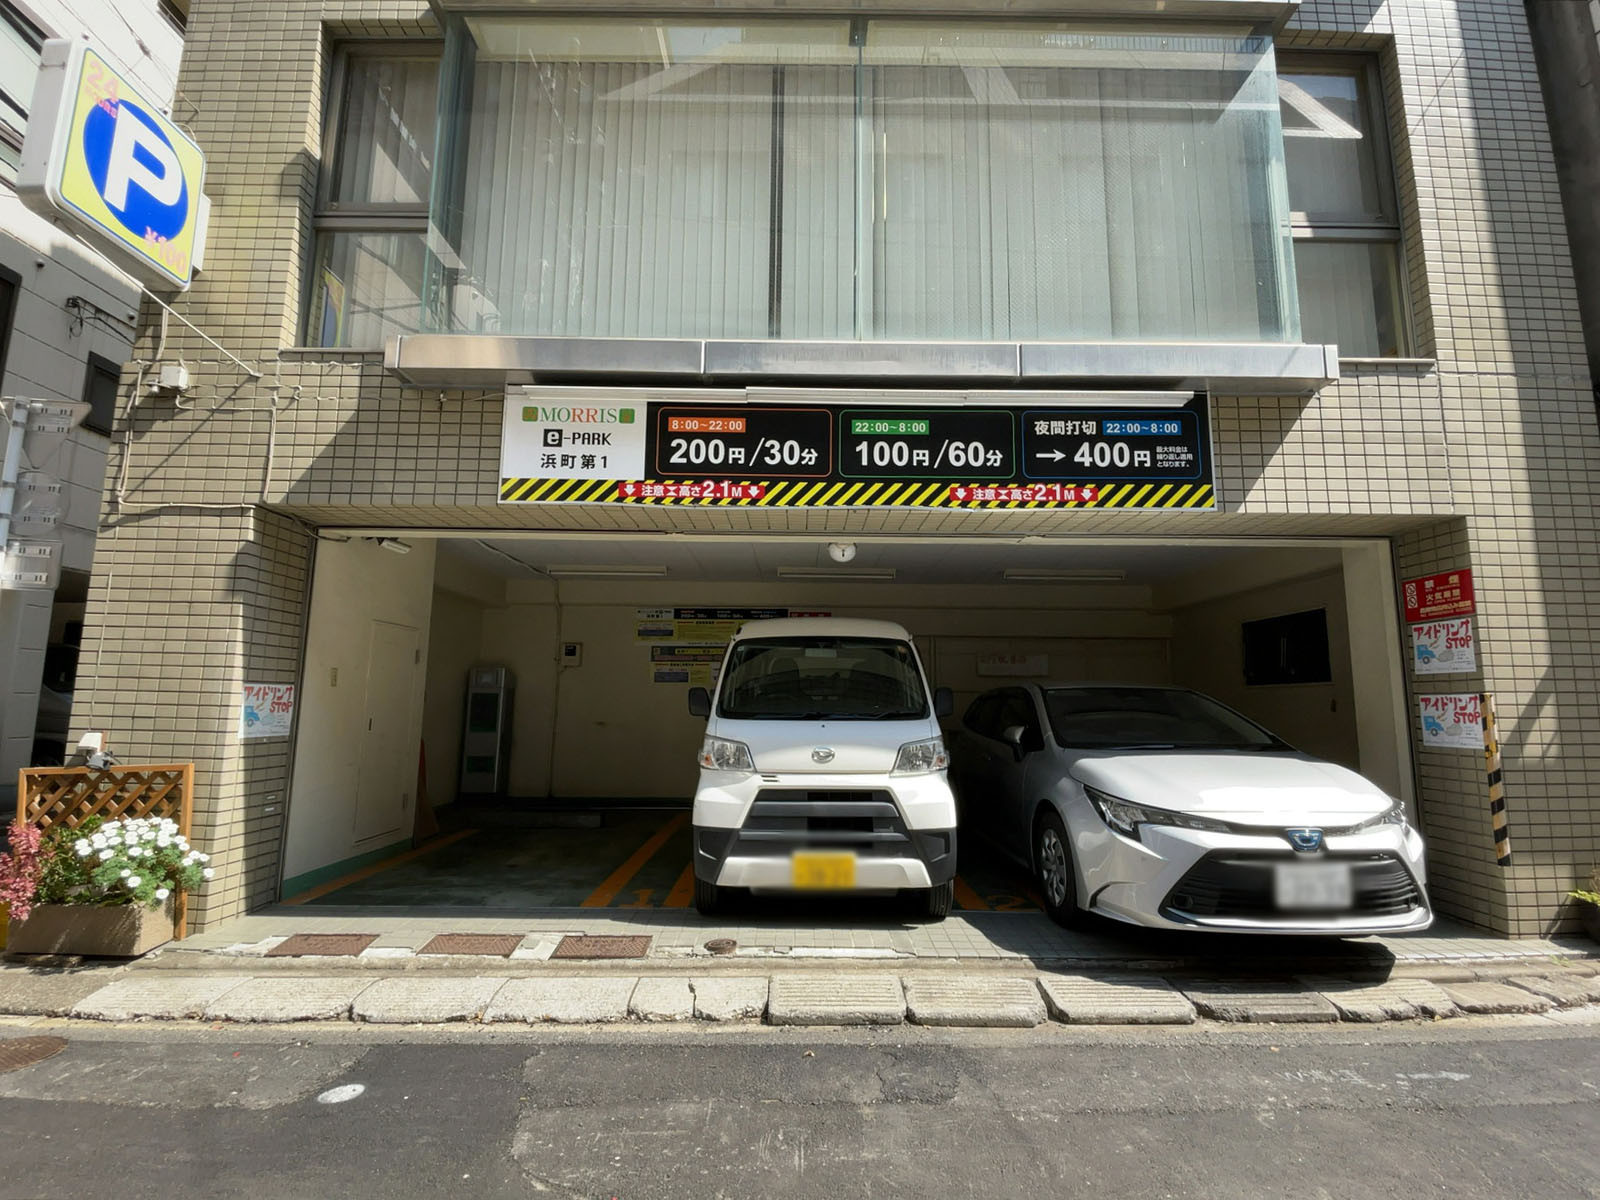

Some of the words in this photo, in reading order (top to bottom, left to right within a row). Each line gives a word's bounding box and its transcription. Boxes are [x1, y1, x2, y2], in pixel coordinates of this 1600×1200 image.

[103, 103, 183, 213] P
[540, 407, 617, 423] MORRIS
[671, 419, 743, 431] 8:00~22:00
[855, 422, 926, 433] 22:00~8:00
[1034, 420, 1097, 436] 夜間打切
[1106, 423, 1178, 433] 22:00~8:00
[540, 453, 608, 470] 浜町第1
[1073, 441, 1151, 467] 400円
[641, 485, 664, 497] 注意
[972, 488, 996, 500] 注意
[1413, 619, 1470, 640] アイドリング
[1445, 635, 1472, 649] STOP
[244, 686, 293, 701] アイドリング
[269, 701, 293, 713] STOP
[1420, 695, 1478, 711] アイドリング
[1453, 711, 1480, 725] STOP
